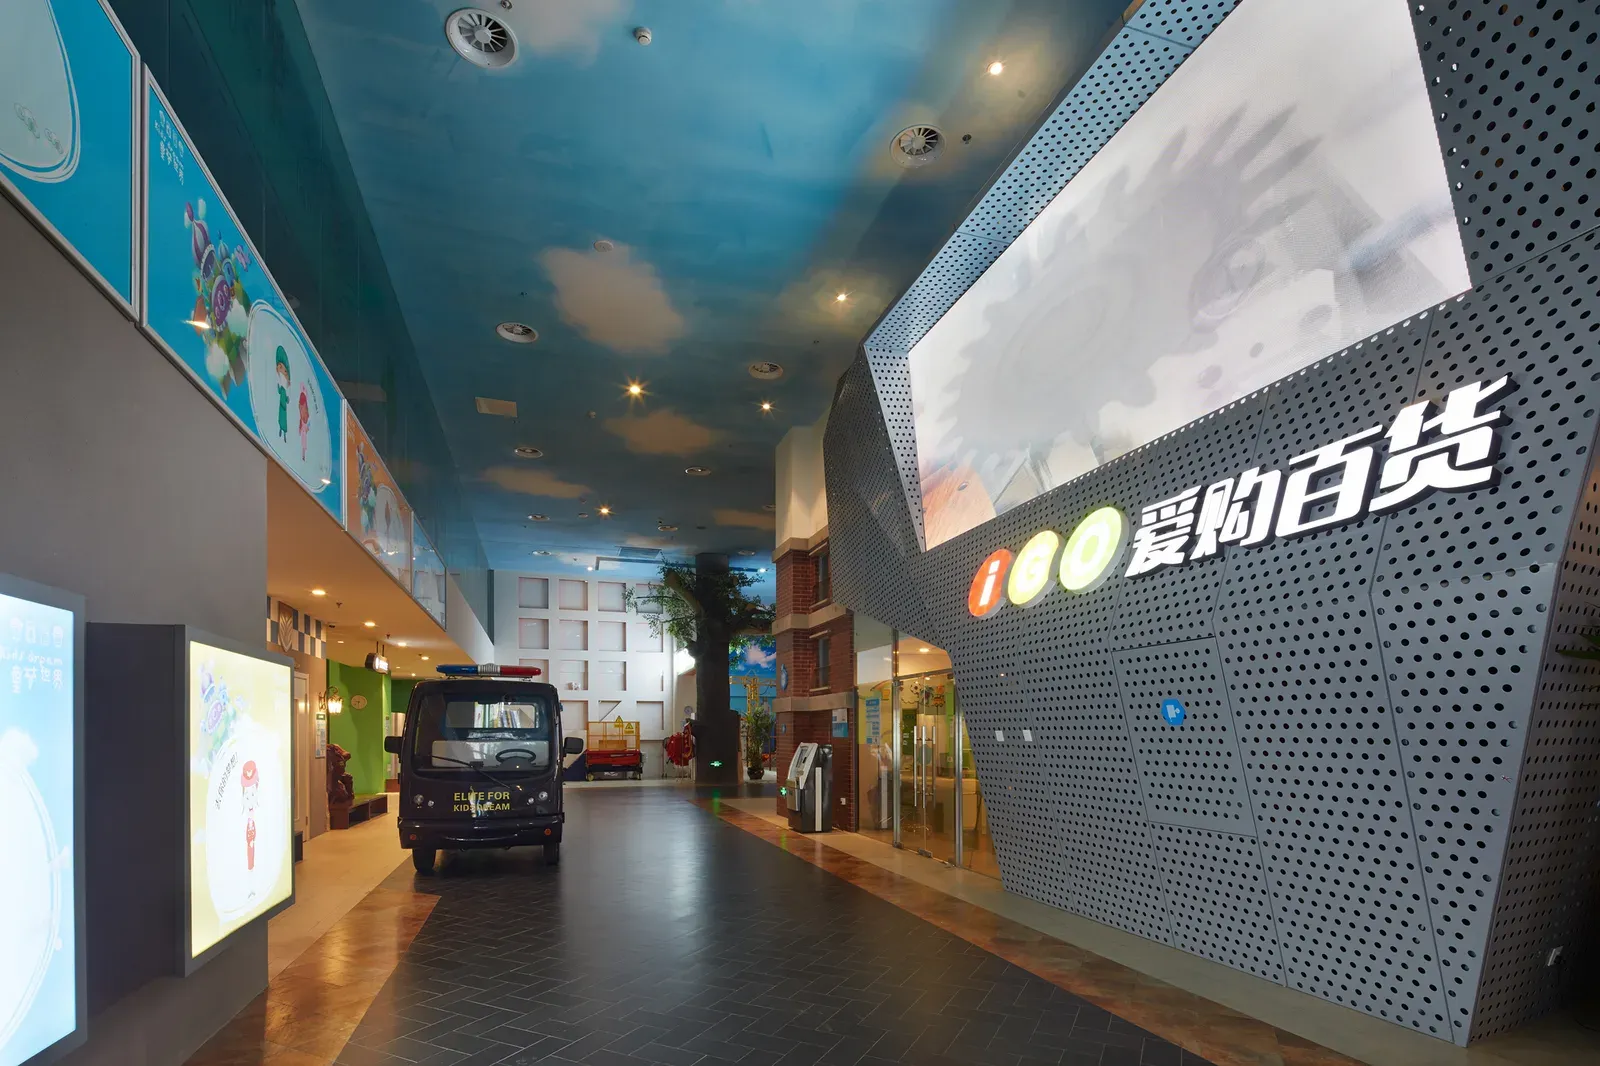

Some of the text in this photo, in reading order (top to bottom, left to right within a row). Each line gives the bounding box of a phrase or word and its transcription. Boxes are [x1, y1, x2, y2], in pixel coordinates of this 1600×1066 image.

[1124, 375, 1508, 578] 爱购百货
[454, 791, 510, 801] ELITE FOR
